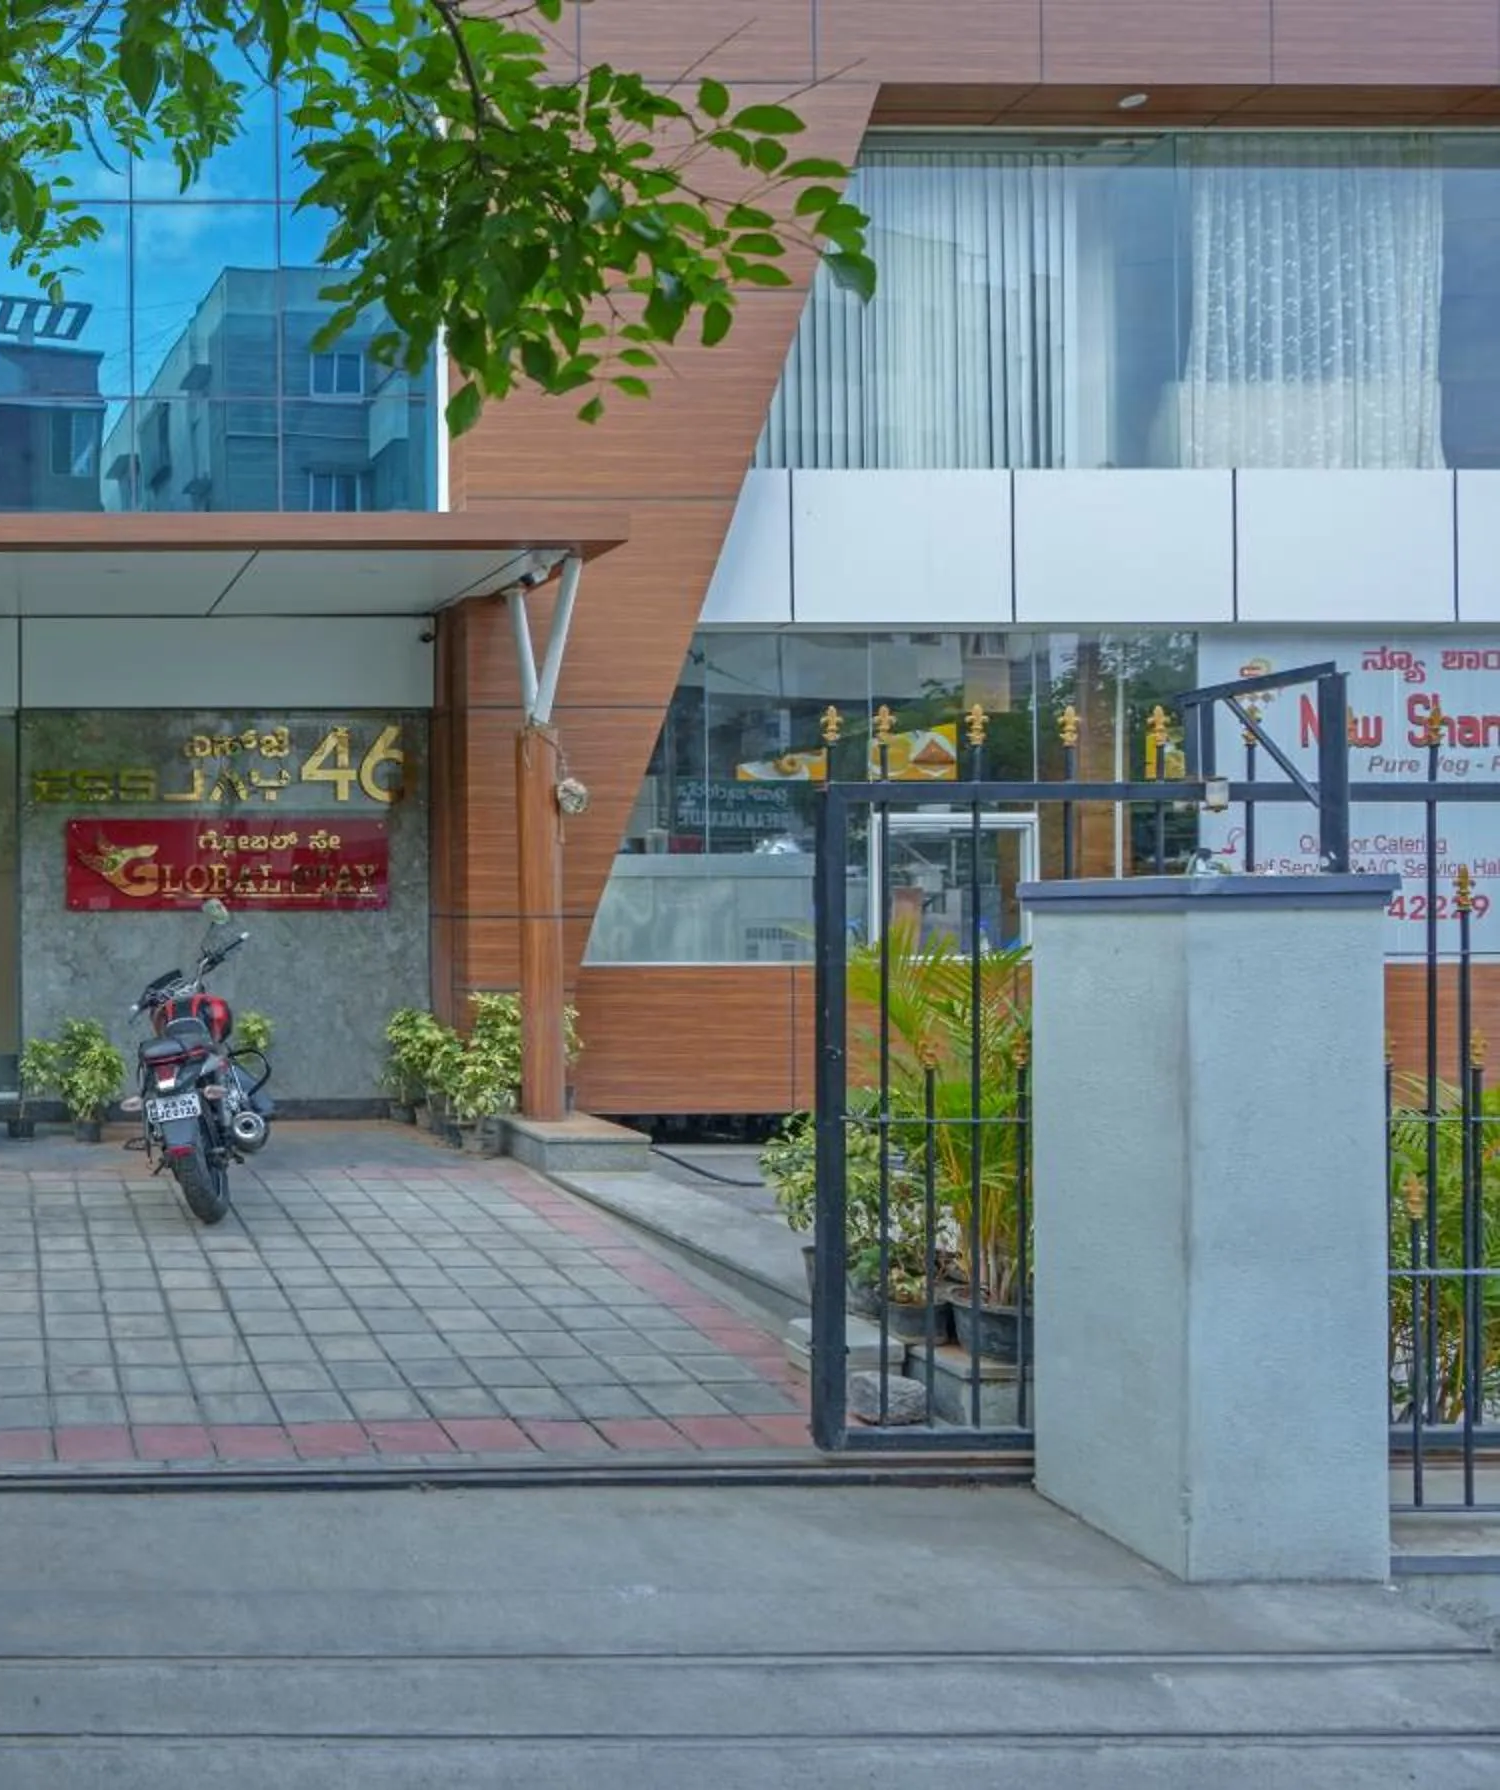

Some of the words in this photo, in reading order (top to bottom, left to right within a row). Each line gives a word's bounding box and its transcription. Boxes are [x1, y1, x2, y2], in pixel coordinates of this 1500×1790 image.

[1300, 693, 1383, 749] Nw
[301, 725, 414, 802] 46
[1368, 755, 1420, 773] Pure
[1437, 754, 1470, 777] eg
[100, 845, 282, 895] GLOBAL
